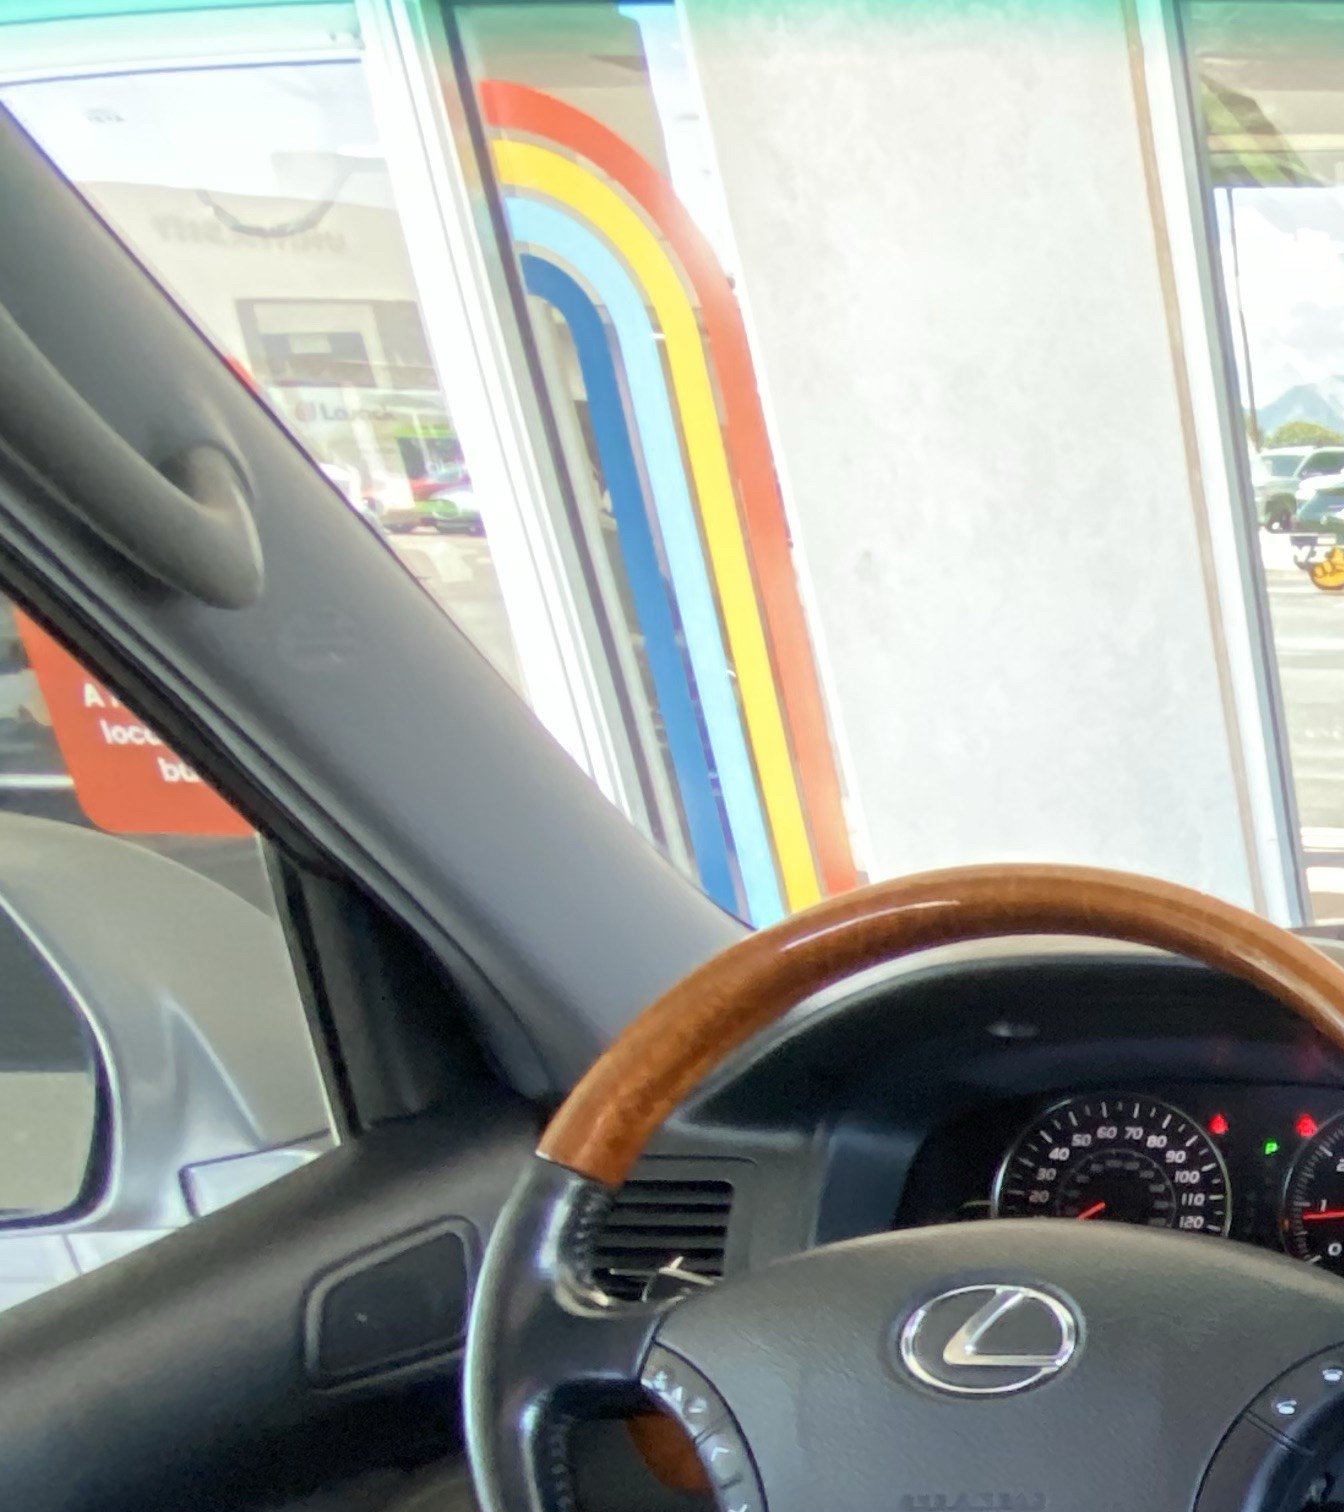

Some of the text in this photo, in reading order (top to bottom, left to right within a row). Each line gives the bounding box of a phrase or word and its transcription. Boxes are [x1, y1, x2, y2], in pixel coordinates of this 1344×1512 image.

[84, 683, 105, 707] A
[1096, 1127, 1118, 1139] 60
[1124, 1127, 1144, 1140] 70
[1071, 1134, 1092, 1147] 50
[1146, 1136, 1167, 1148] 80
[1049, 1147, 1070, 1161] 40
[1165, 1150, 1187, 1164] 90
[1037, 1168, 1057, 1181] 30
[1174, 1171, 1200, 1184] 100
[1028, 1190, 1050, 1203] 20
[1181, 1193, 1205, 1206] 110
[1179, 1216, 1204, 1229] 120
[1327, 1242, 1343, 1257] 0
